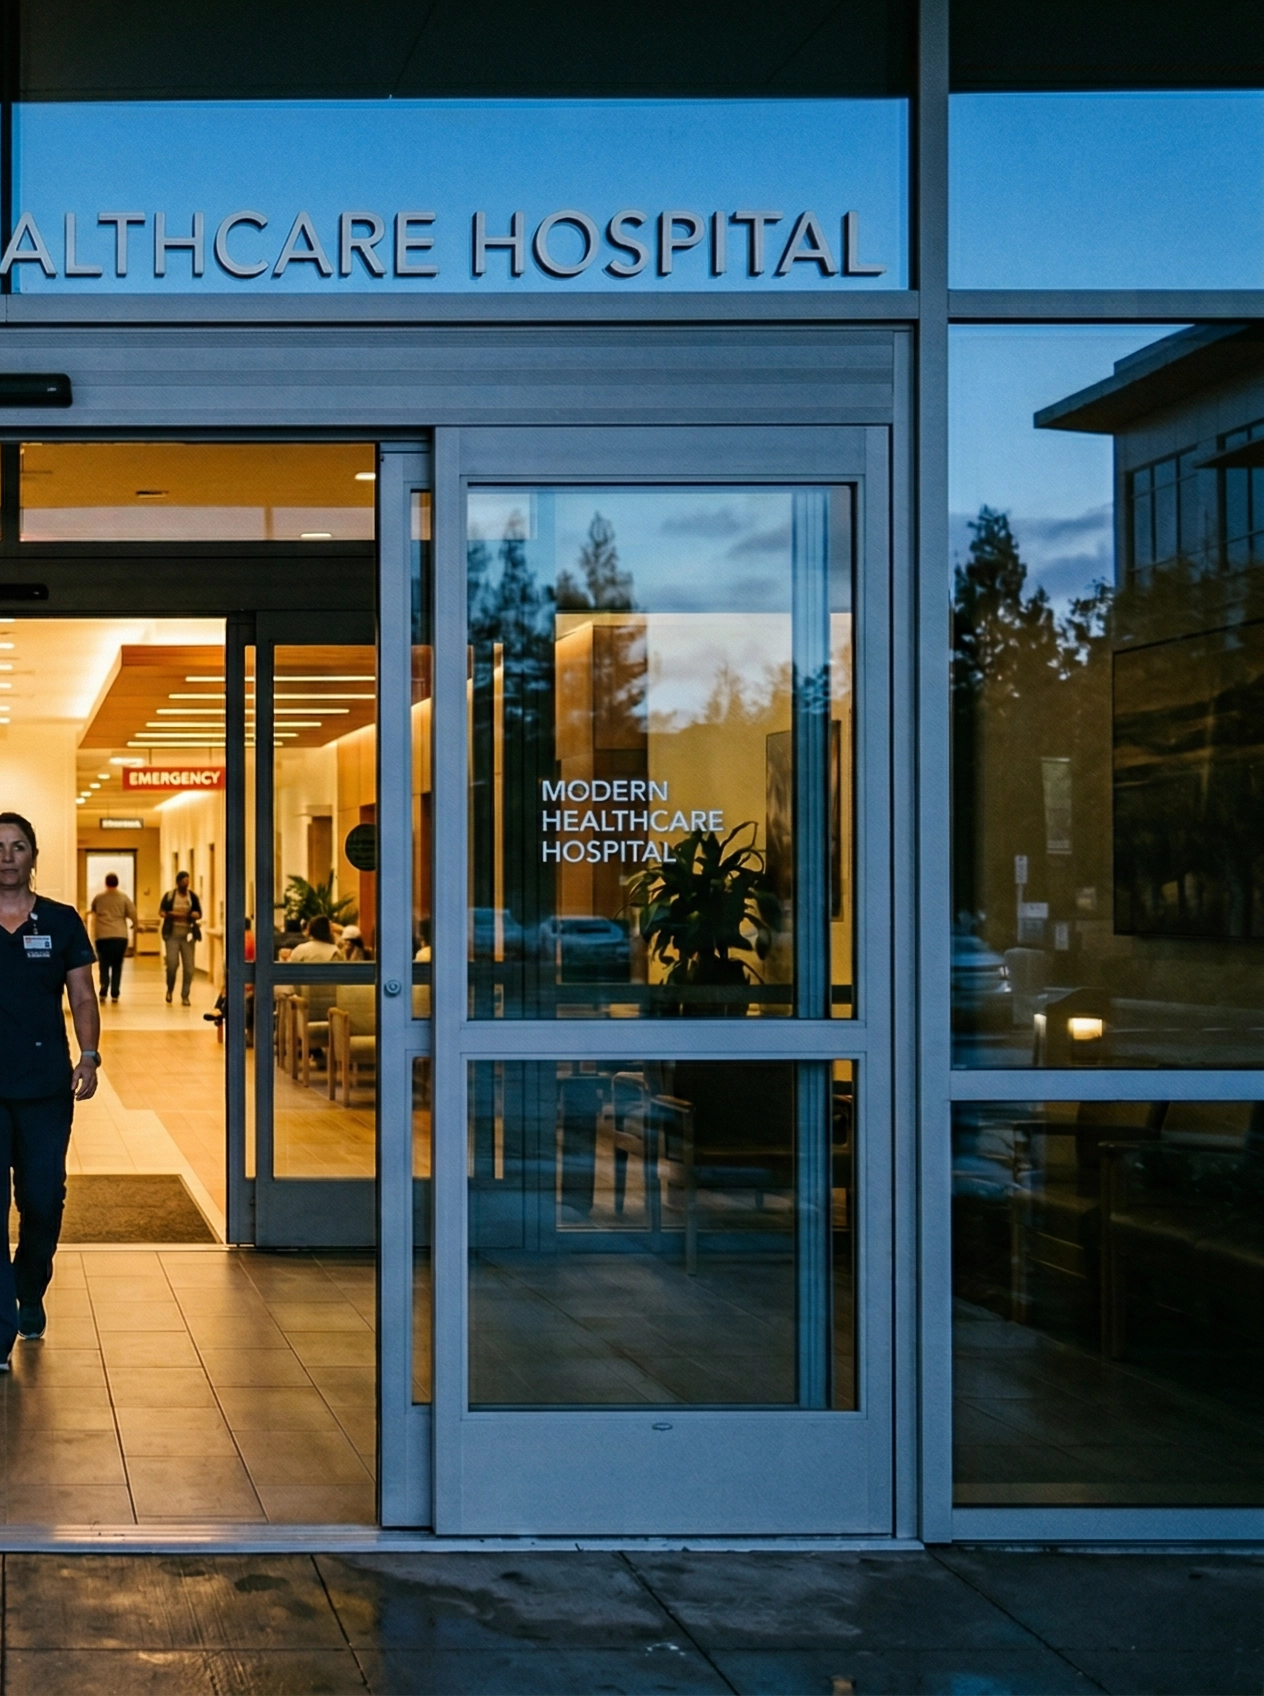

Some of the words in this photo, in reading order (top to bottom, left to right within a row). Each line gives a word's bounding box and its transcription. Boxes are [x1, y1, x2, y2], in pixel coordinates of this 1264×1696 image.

[471, 209, 887, 279] HOSPITAL
[129, 770, 221, 786] EMERGENCY
[541, 780, 668, 802] MODERN
[541, 810, 724, 832] HEALTHCARE
[541, 840, 677, 863] HOSPITAL
